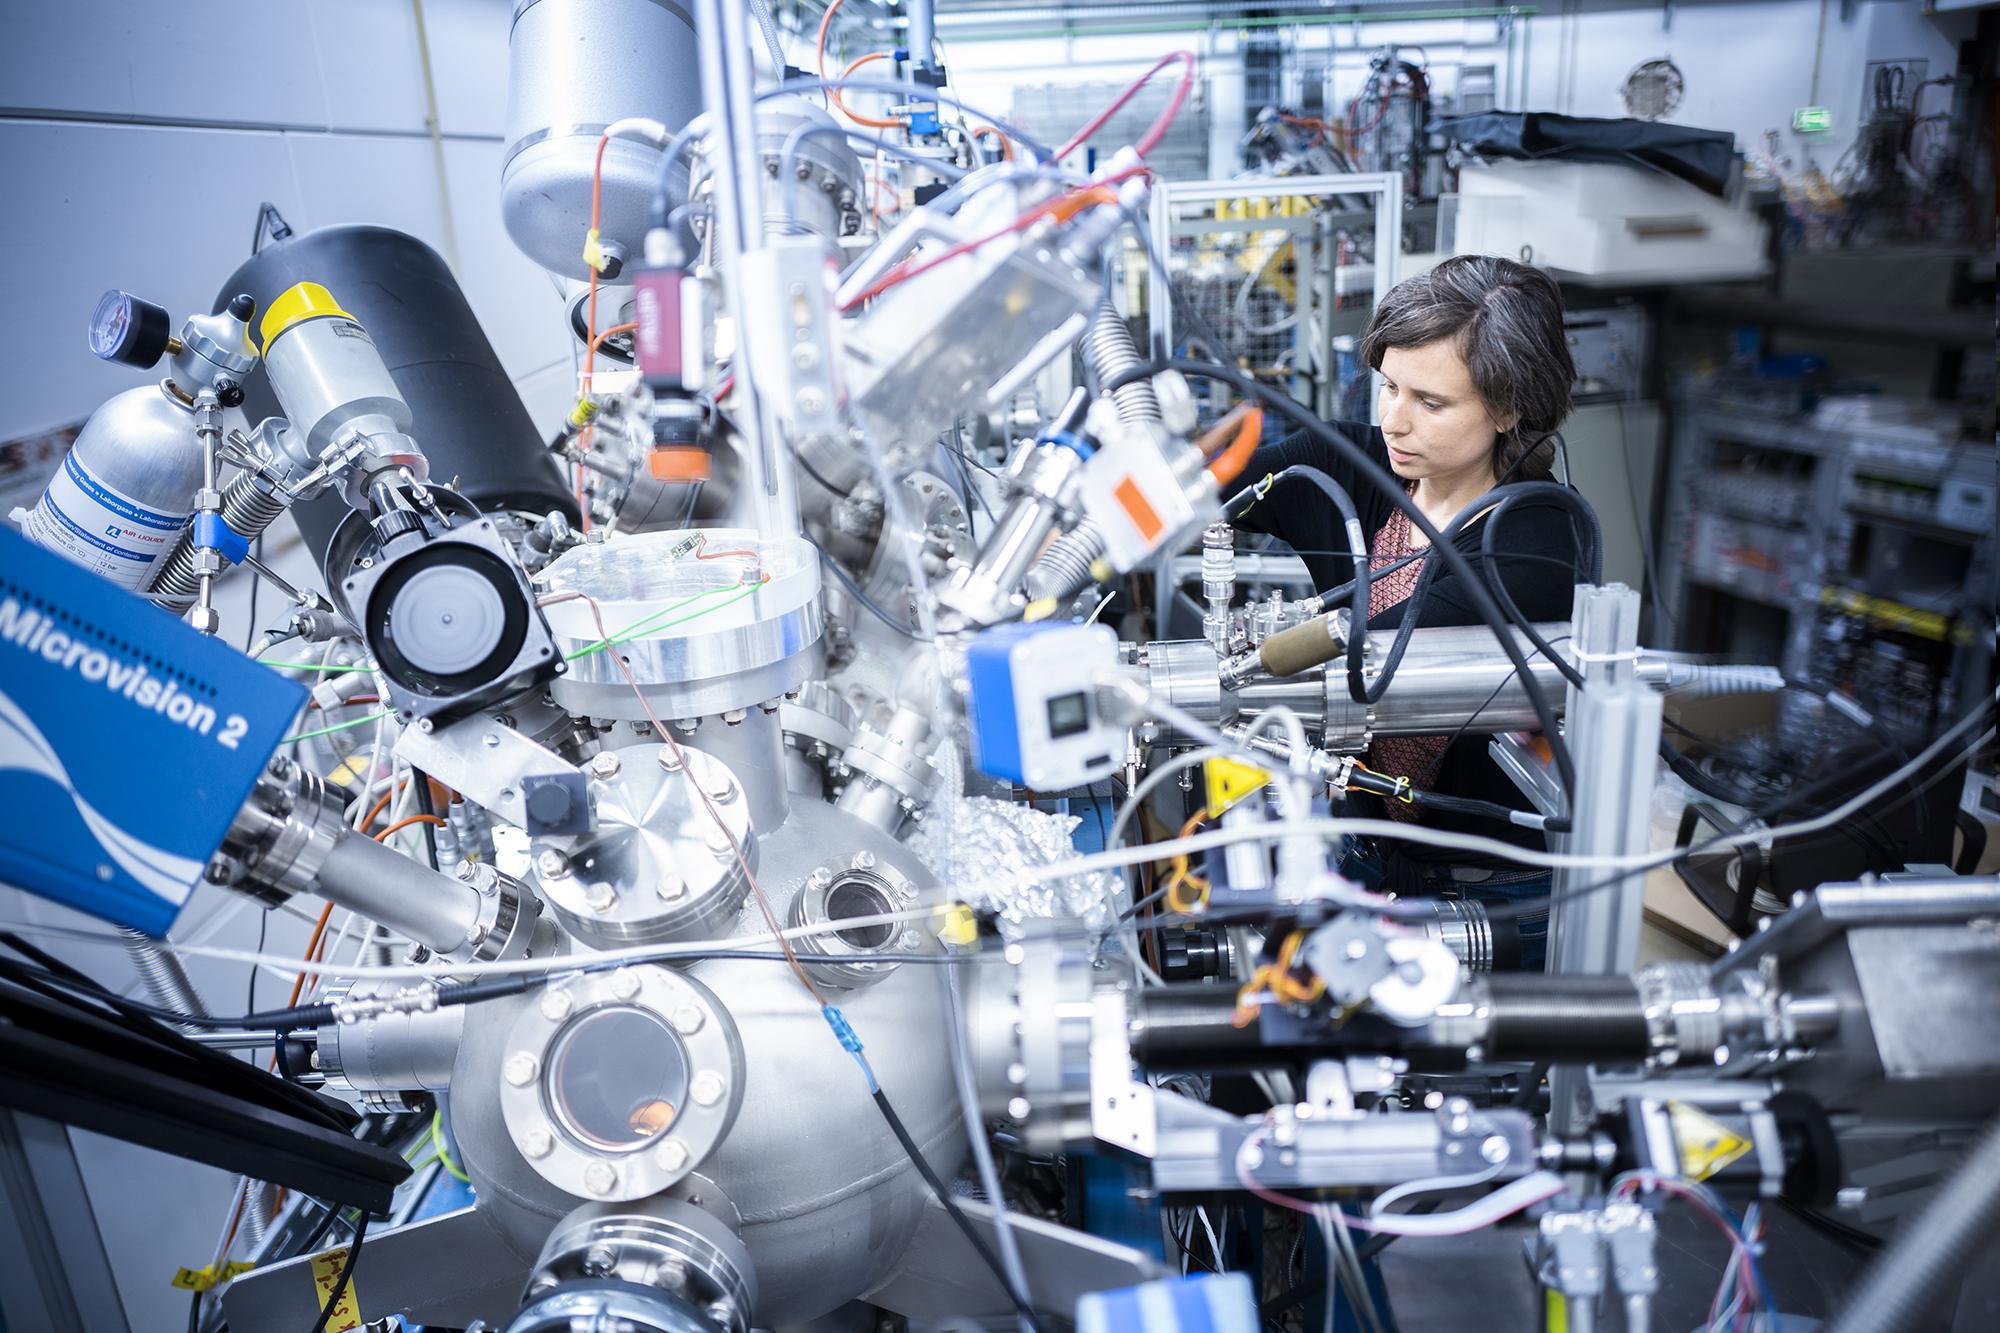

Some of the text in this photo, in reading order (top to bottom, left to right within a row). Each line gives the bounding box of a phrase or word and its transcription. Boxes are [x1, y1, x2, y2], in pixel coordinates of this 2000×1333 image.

[139, 513, 171, 527] Laboratory
[48, 529, 67, 546] pressure
[122, 528, 137, 538] AIR
[106, 545, 115, 553] of
[114, 549, 140, 560] contents
[107, 563, 118, 571] bar
[0, 597, 249, 750] Microvision 2
